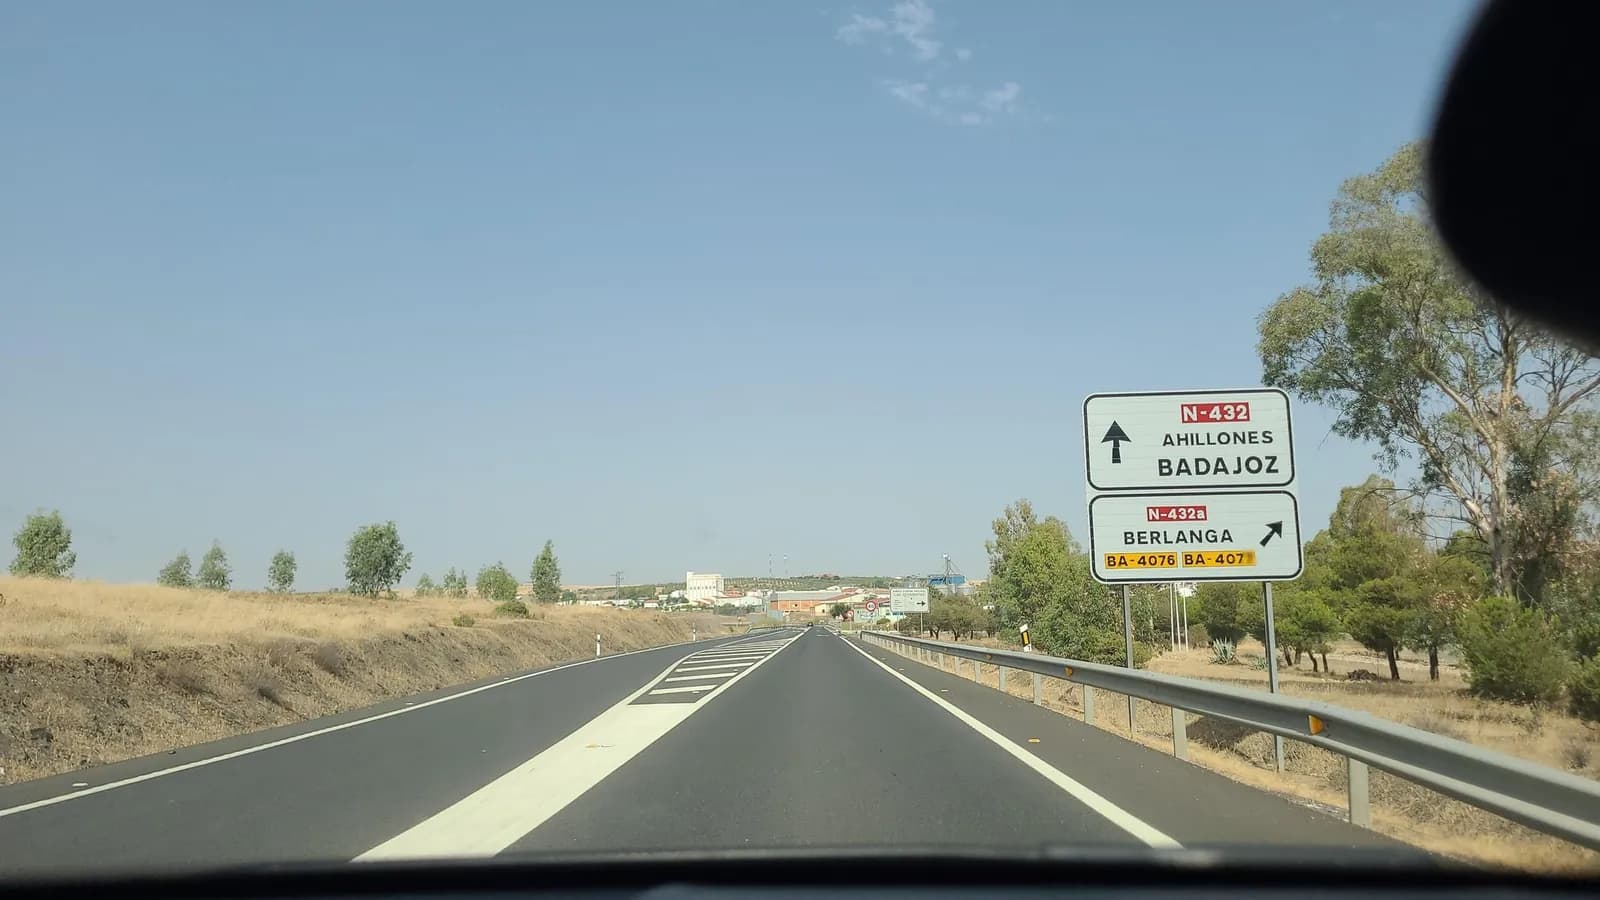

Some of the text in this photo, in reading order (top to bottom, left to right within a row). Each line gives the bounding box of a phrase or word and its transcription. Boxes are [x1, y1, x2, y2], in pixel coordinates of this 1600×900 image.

[1183, 404, 1248, 421] N-432
[1162, 430, 1274, 446] AHILLONES
[1158, 455, 1279, 477] BADAJOZ
[1148, 508, 1206, 520] N-432a
[1123, 529, 1233, 545] BERLANGA
[1106, 554, 1176, 567] BA-4076
[1184, 552, 1253, 565] BA-407
